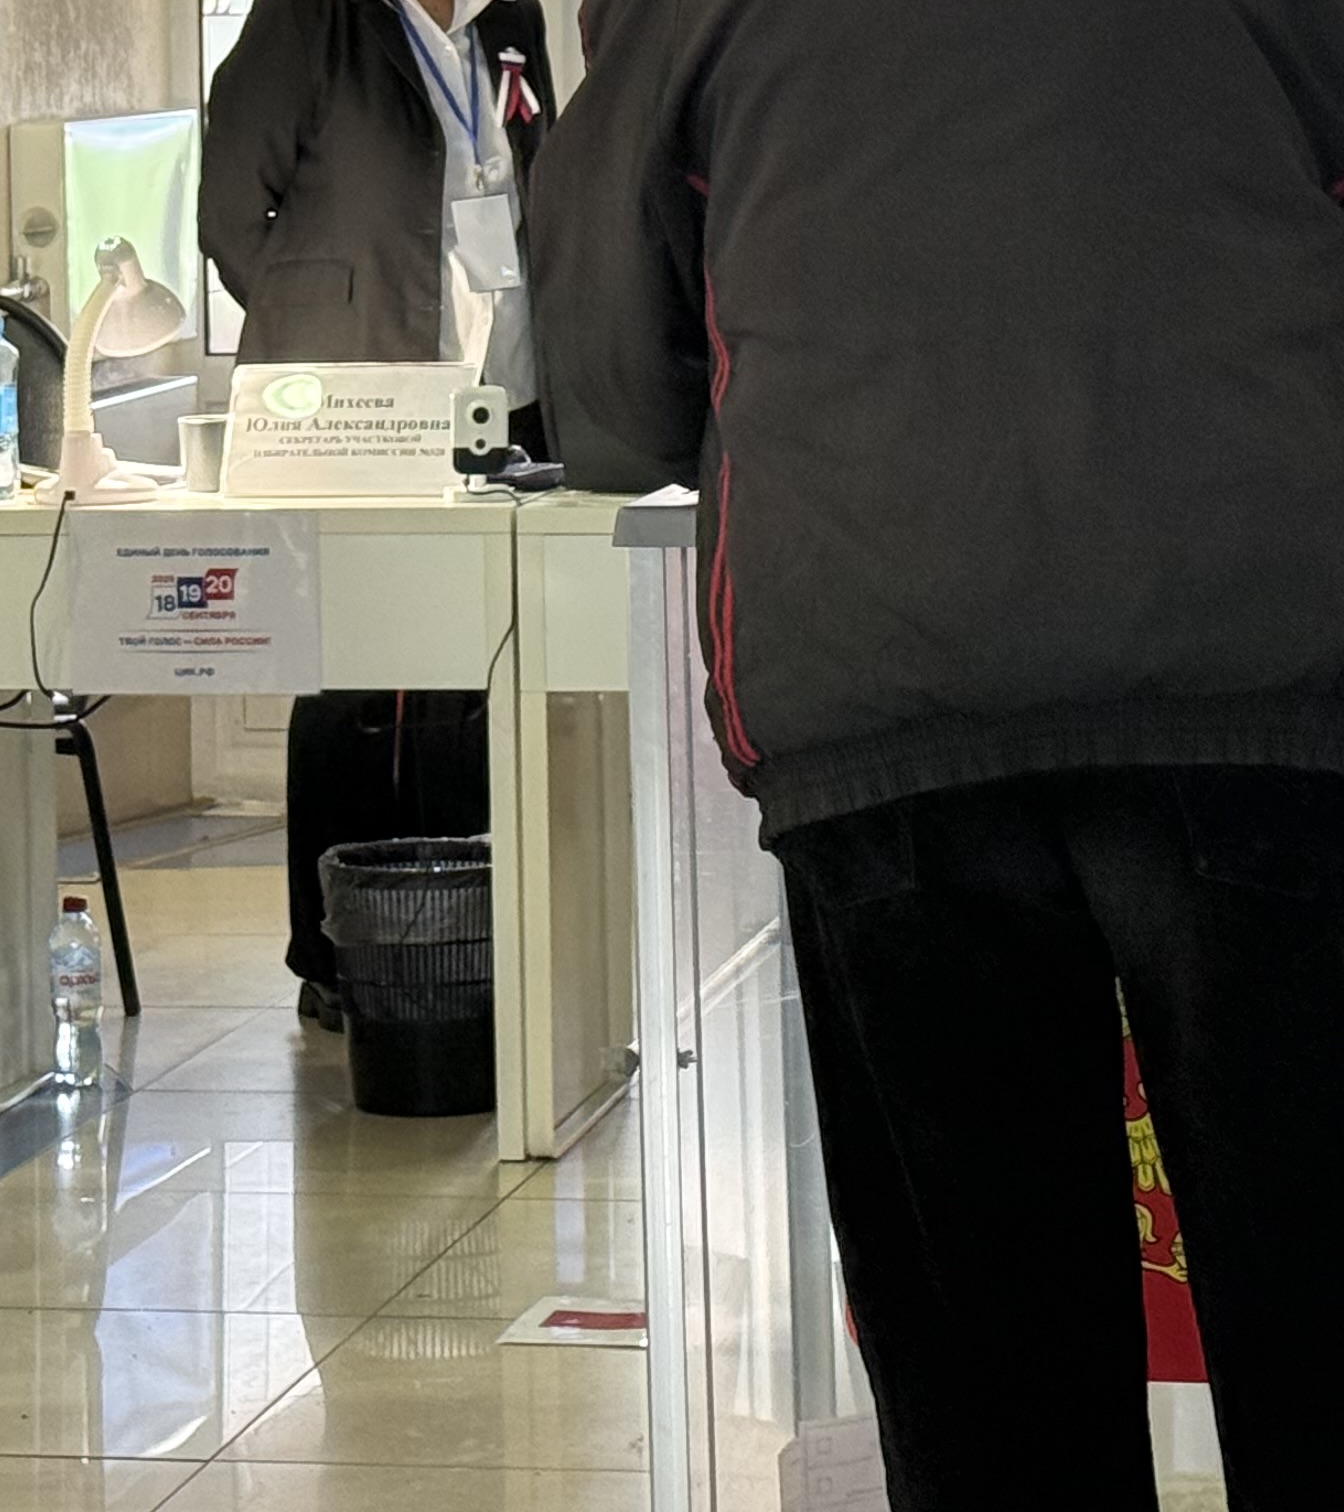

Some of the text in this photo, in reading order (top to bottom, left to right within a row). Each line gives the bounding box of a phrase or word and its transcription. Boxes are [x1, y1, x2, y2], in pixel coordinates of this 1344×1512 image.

[246, 417, 451, 434] Юлия Александровна
[179, 584, 201, 603] 19
[206, 575, 232, 594] 20
[155, 594, 177, 612] 18
